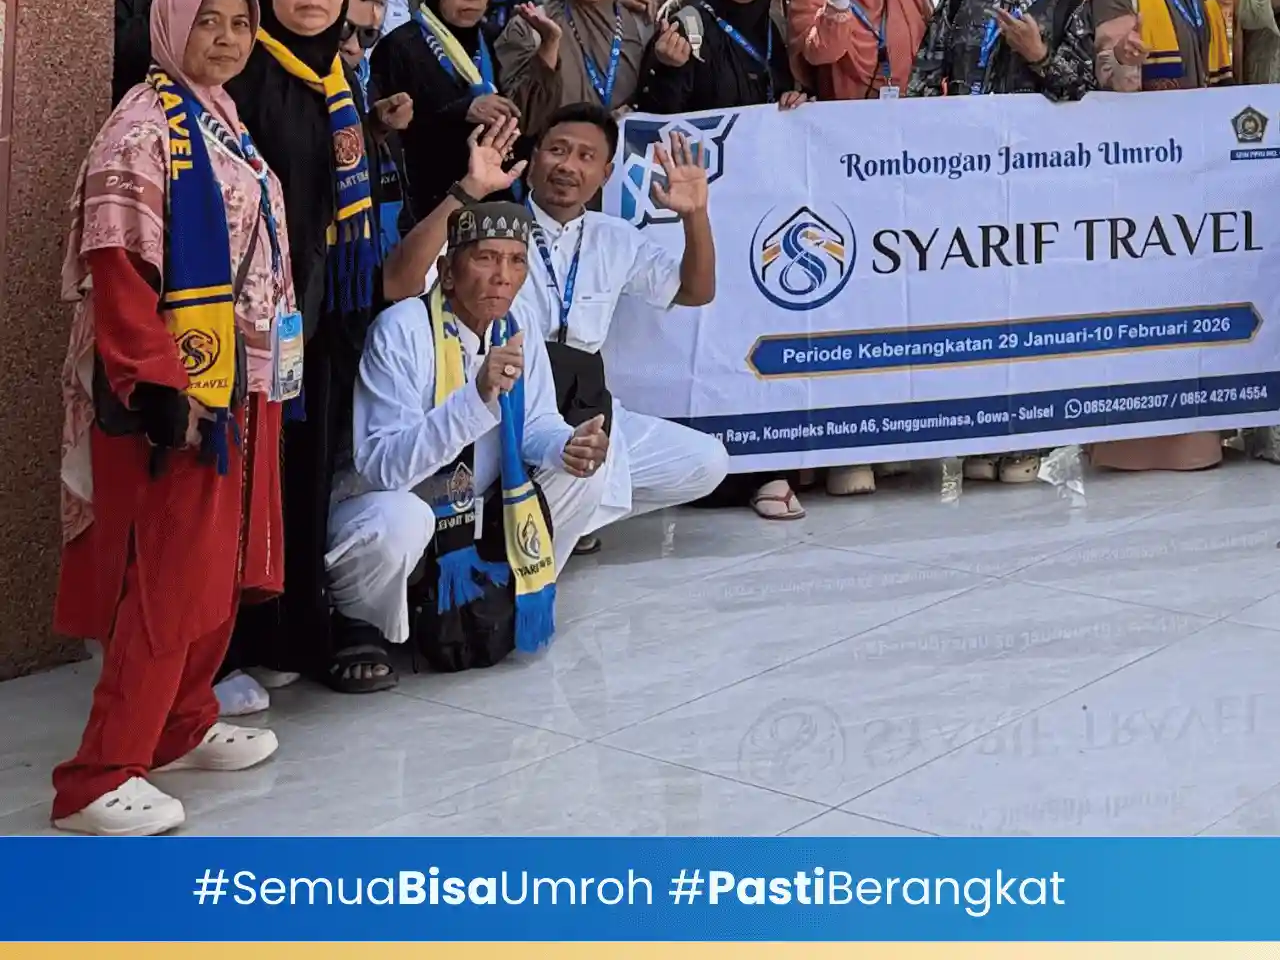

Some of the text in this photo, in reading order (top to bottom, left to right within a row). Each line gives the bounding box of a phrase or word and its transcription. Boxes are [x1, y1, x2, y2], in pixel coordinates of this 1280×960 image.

[152, 72, 194, 181] RAVEL
[840, 138, 1184, 181] Rombongan Jamaah Umroh
[872, 210, 1264, 274] SYARIF TRAVEL
[783, 316, 1231, 364] Periode Keberangkatan 29 Januari-10 Februari 2026
[726, 429, 761, 444] Raya,
[763, 423, 824, 440] Kompleks
[826, 421, 858, 436] Ruko
[860, 419, 880, 434] A6,
[881, 414, 975, 433] Sungguminasa,
[976, 410, 1010, 424] Gowa
[1018, 404, 1054, 420] Sulsel
[1083, 394, 1169, 415] 085242062307
[1180, 390, 1208, 407] 0852
[1209, 388, 1237, 403] 4276
[1239, 385, 1268, 400] 4554
